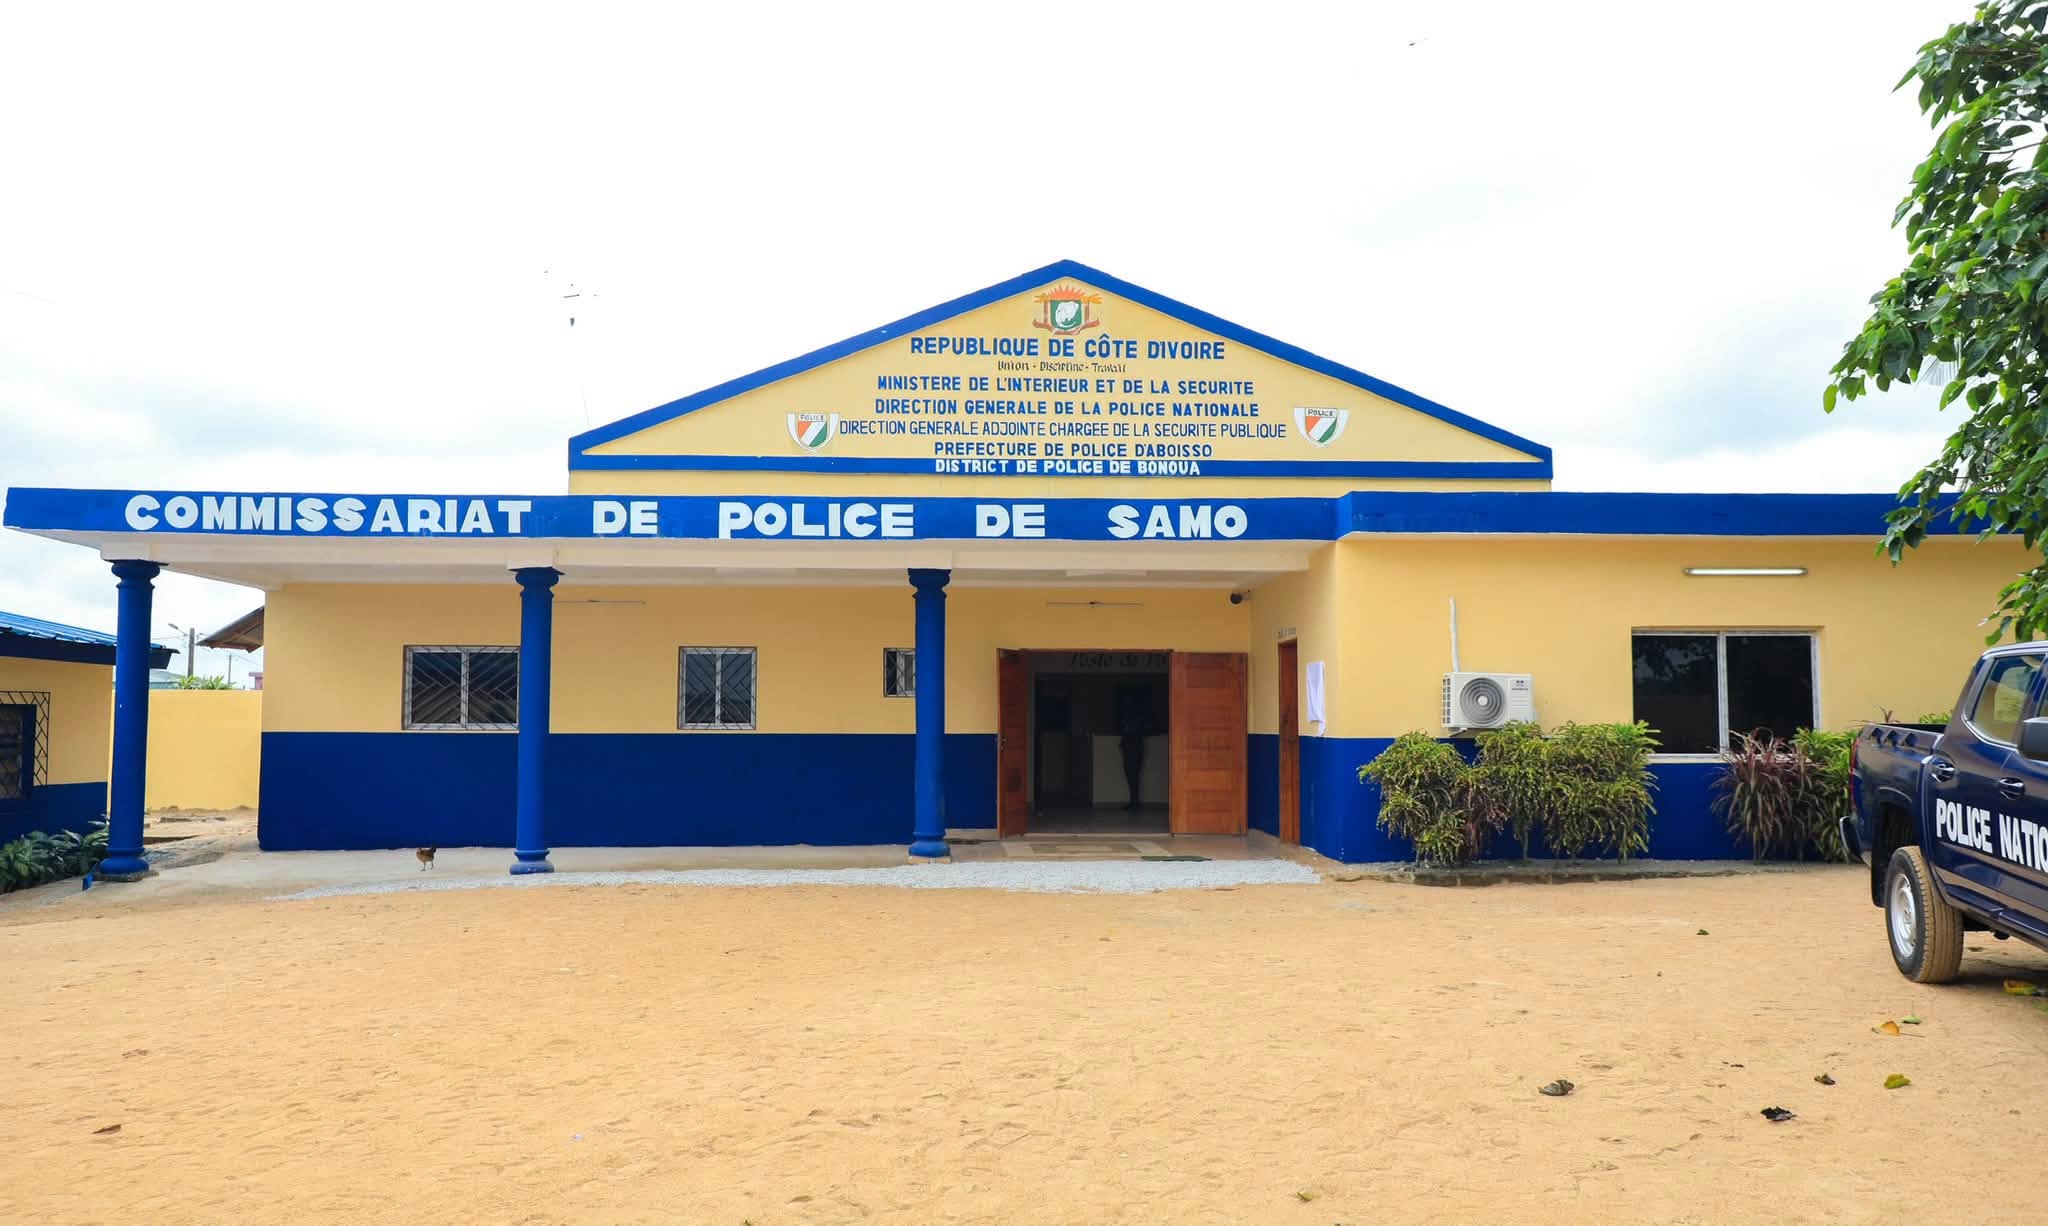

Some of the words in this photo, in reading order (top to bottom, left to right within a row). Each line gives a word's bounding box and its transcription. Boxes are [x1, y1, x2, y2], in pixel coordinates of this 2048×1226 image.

[911, 337, 1038, 356] REPUBLIQUE
[1049, 339, 1074, 357] DE
[1085, 334, 1137, 358] CÔTE
[997, 360, 1029, 371] Union
[878, 376, 960, 390] MINISTERE
[969, 377, 988, 391] DE
[997, 378, 1088, 392] L'INTERIEUR
[1096, 380, 1115, 392] ET
[1124, 380, 1142, 393] DE
[1151, 381, 1169, 393] LA
[1178, 381, 1253, 395] SECURITE
[876, 399, 956, 414] DIRECTION
[965, 400, 1046, 414] GENERALE
[1055, 402, 1073, 414] DE
[1082, 402, 1100, 414] LA
[1109, 402, 1164, 416] POLICE
[1173, 403, 1258, 416] NATIONALE
[840, 421, 905, 434] DIRECTION
[910, 421, 978, 435] GENERALE
[983, 422, 1045, 435] ADJOINTE
[1050, 423, 1108, 436] CHARGEE
[1114, 423, 1129, 436] DE
[1134, 424, 1149, 436] LA
[1155, 424, 1216, 437] SECURITE
[1221, 424, 1286, 438] PUBLIQUE
[935, 442, 1036, 456] PREFECTURE
[1045, 443, 1063, 457] DE
[1072, 443, 1126, 457] POLICE
[936, 459, 1008, 472] DISTRICT
[1017, 459, 1036, 472] DE
[1044, 460, 1102, 473] POLICE
[1110, 460, 1130, 473] DE
[1138, 461, 1199, 475] BONOUA
[124, 494, 531, 534] COMMISSARIAT
[592, 501, 659, 535] DE
[718, 502, 914, 539] POLICE
[975, 504, 1046, 538] DE
[1107, 505, 1248, 539] SAMO
[1936, 798, 1993, 854] POLICE
